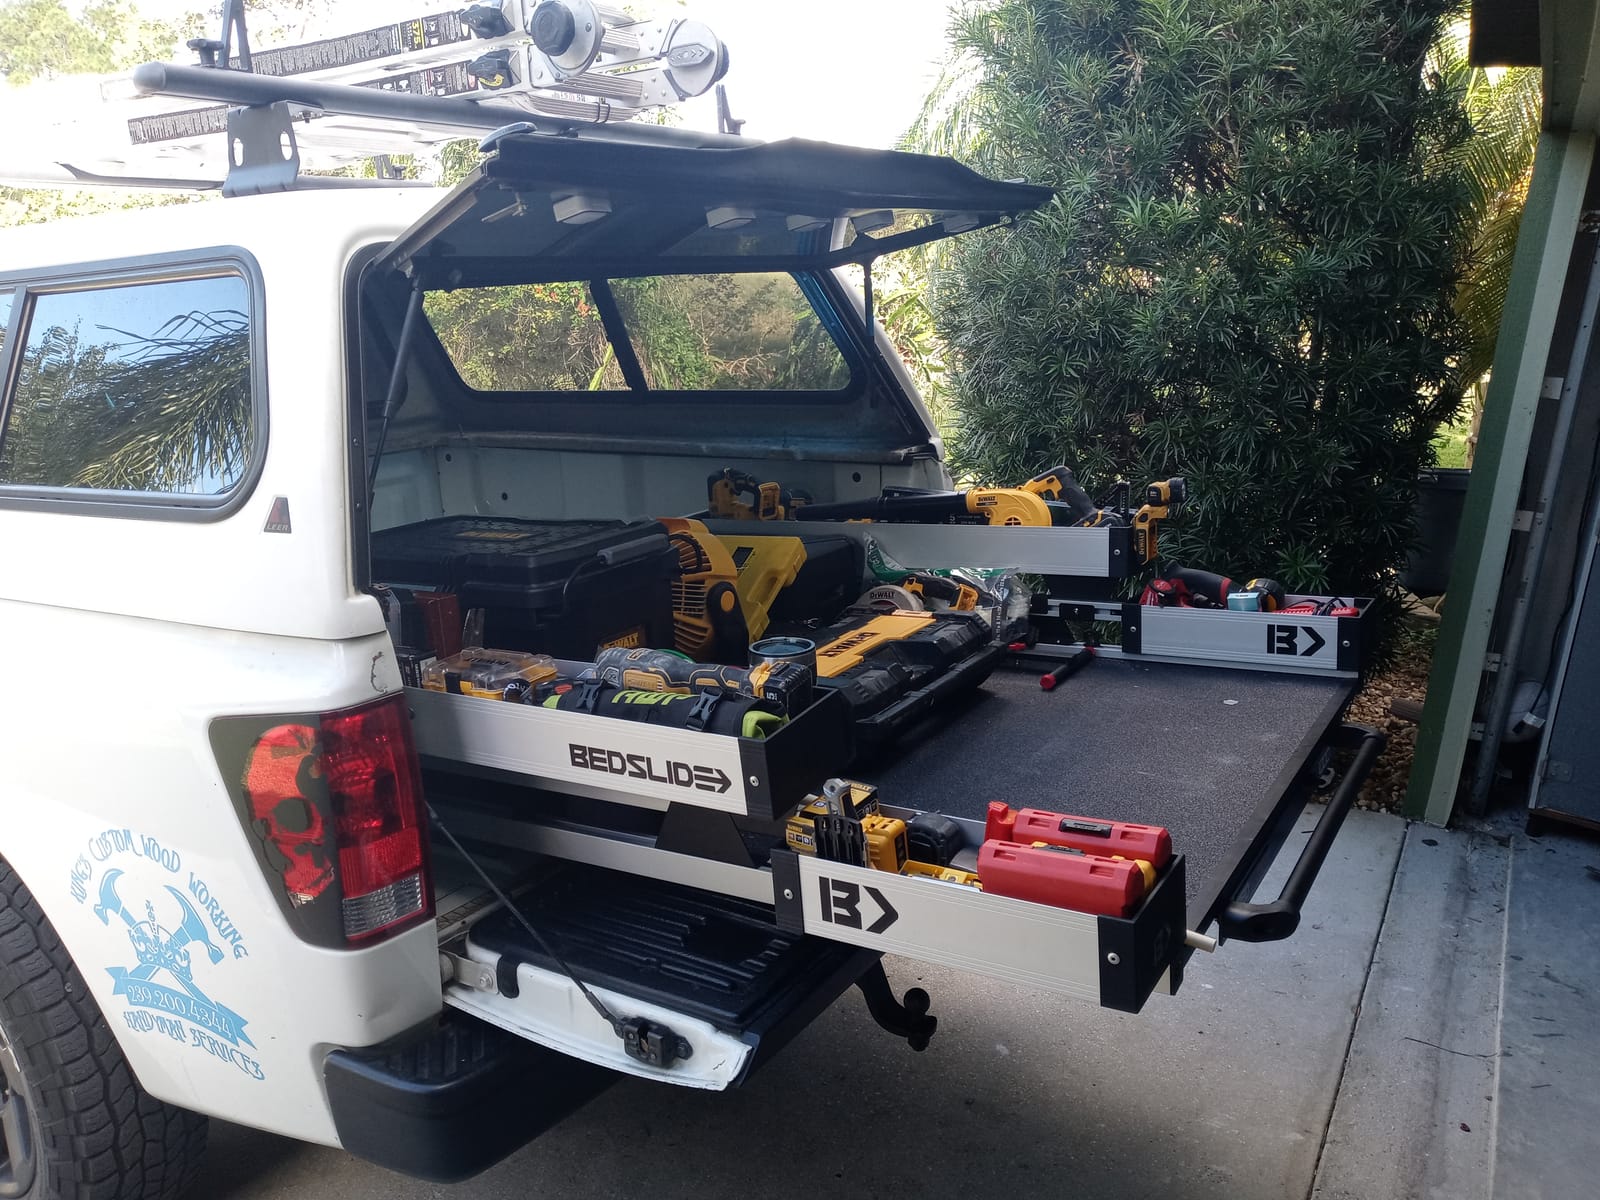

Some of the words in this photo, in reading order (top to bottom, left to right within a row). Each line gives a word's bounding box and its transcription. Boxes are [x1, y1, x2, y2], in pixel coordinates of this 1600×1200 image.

[870, 591, 896, 600] DEWALT
[569, 743, 732, 794] BEDSLIDE
[88, 829, 143, 861] CUSTOM
[141, 834, 181, 873] WOOD
[188, 872, 249, 960] WORKING
[123, 1010, 187, 1043] HANDYMAN
[190, 1027, 265, 1080] SERVICES
